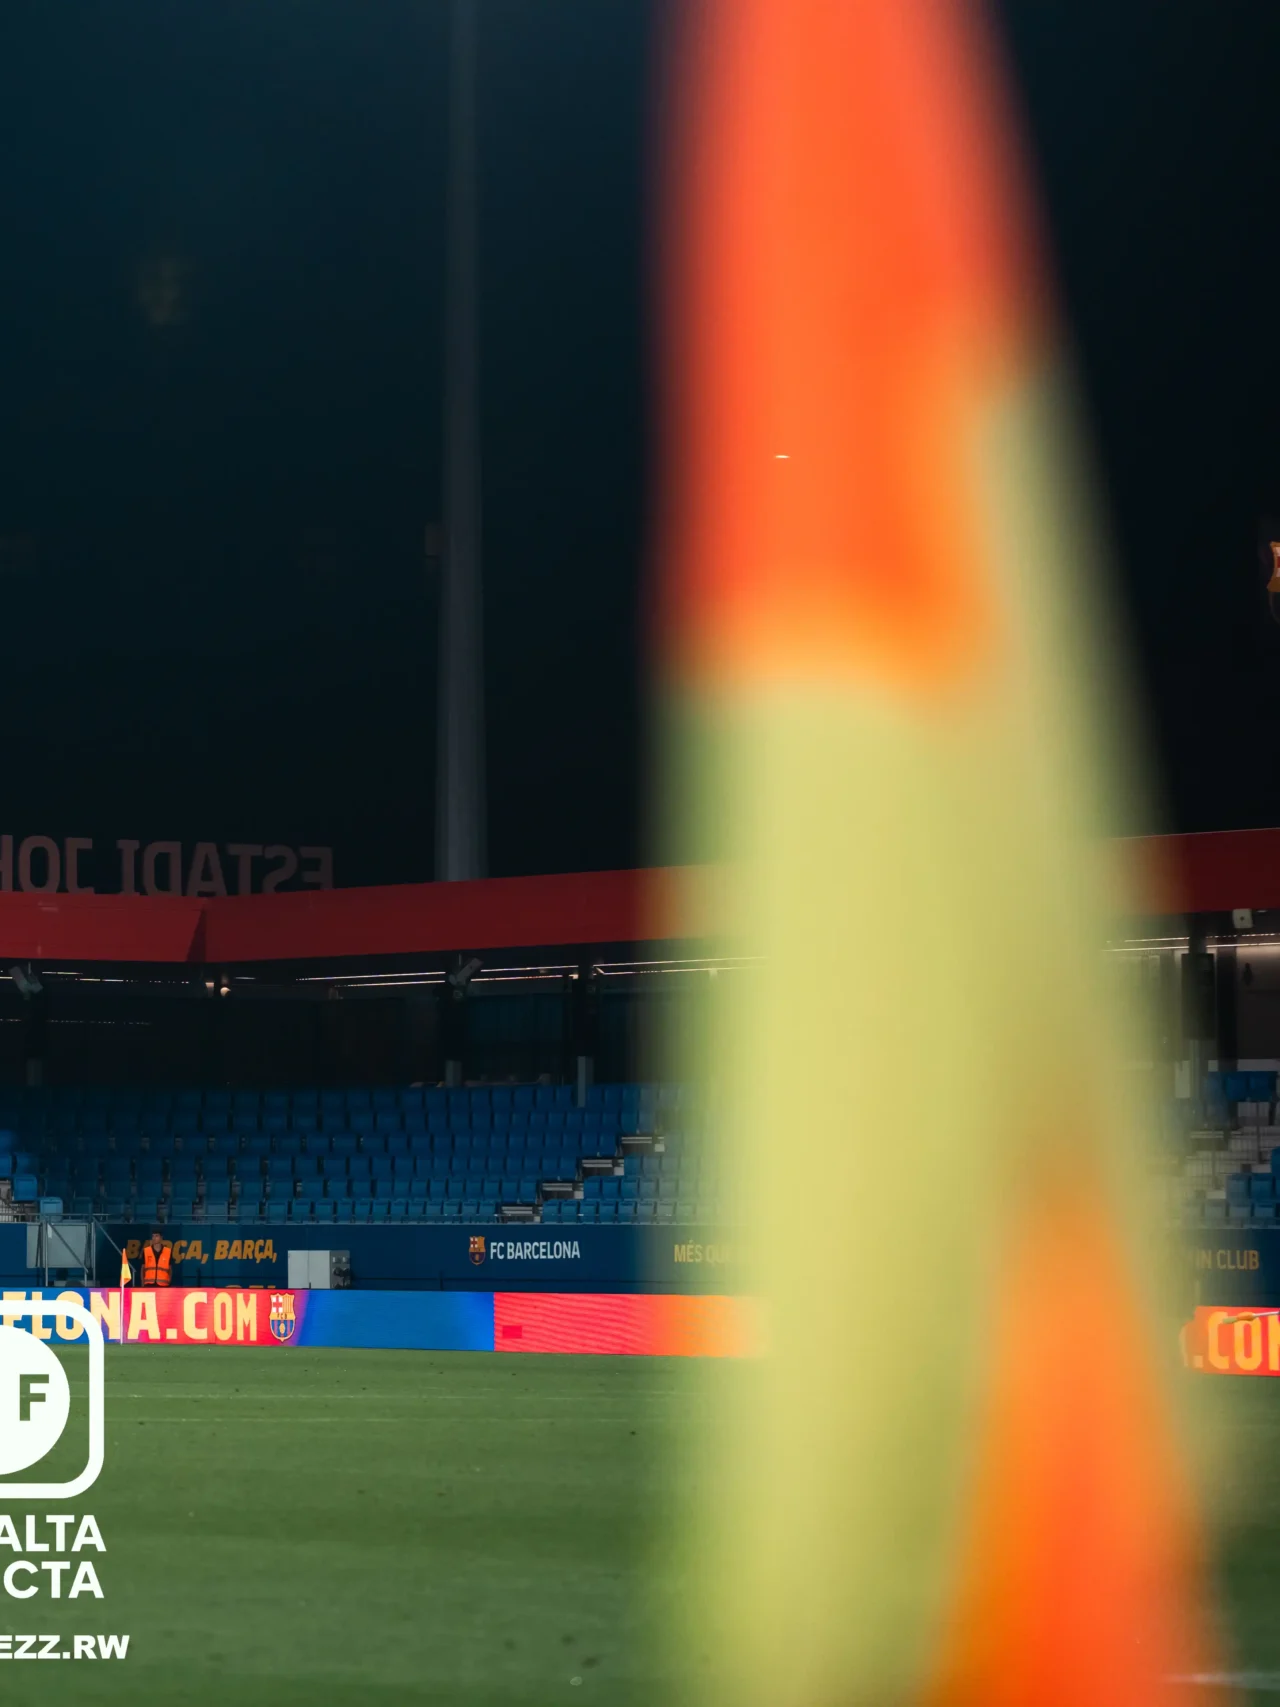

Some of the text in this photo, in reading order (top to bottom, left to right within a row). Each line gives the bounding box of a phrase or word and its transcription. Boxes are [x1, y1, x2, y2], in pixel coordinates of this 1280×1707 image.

[126, 1239, 209, 1264] BÇA,
[214, 1239, 278, 1263] BARÇA,
[490, 1241, 581, 1260] FC BARCELONA
[673, 1239, 703, 1263] MÉS
[1216, 1249, 1260, 1270] CLUB
